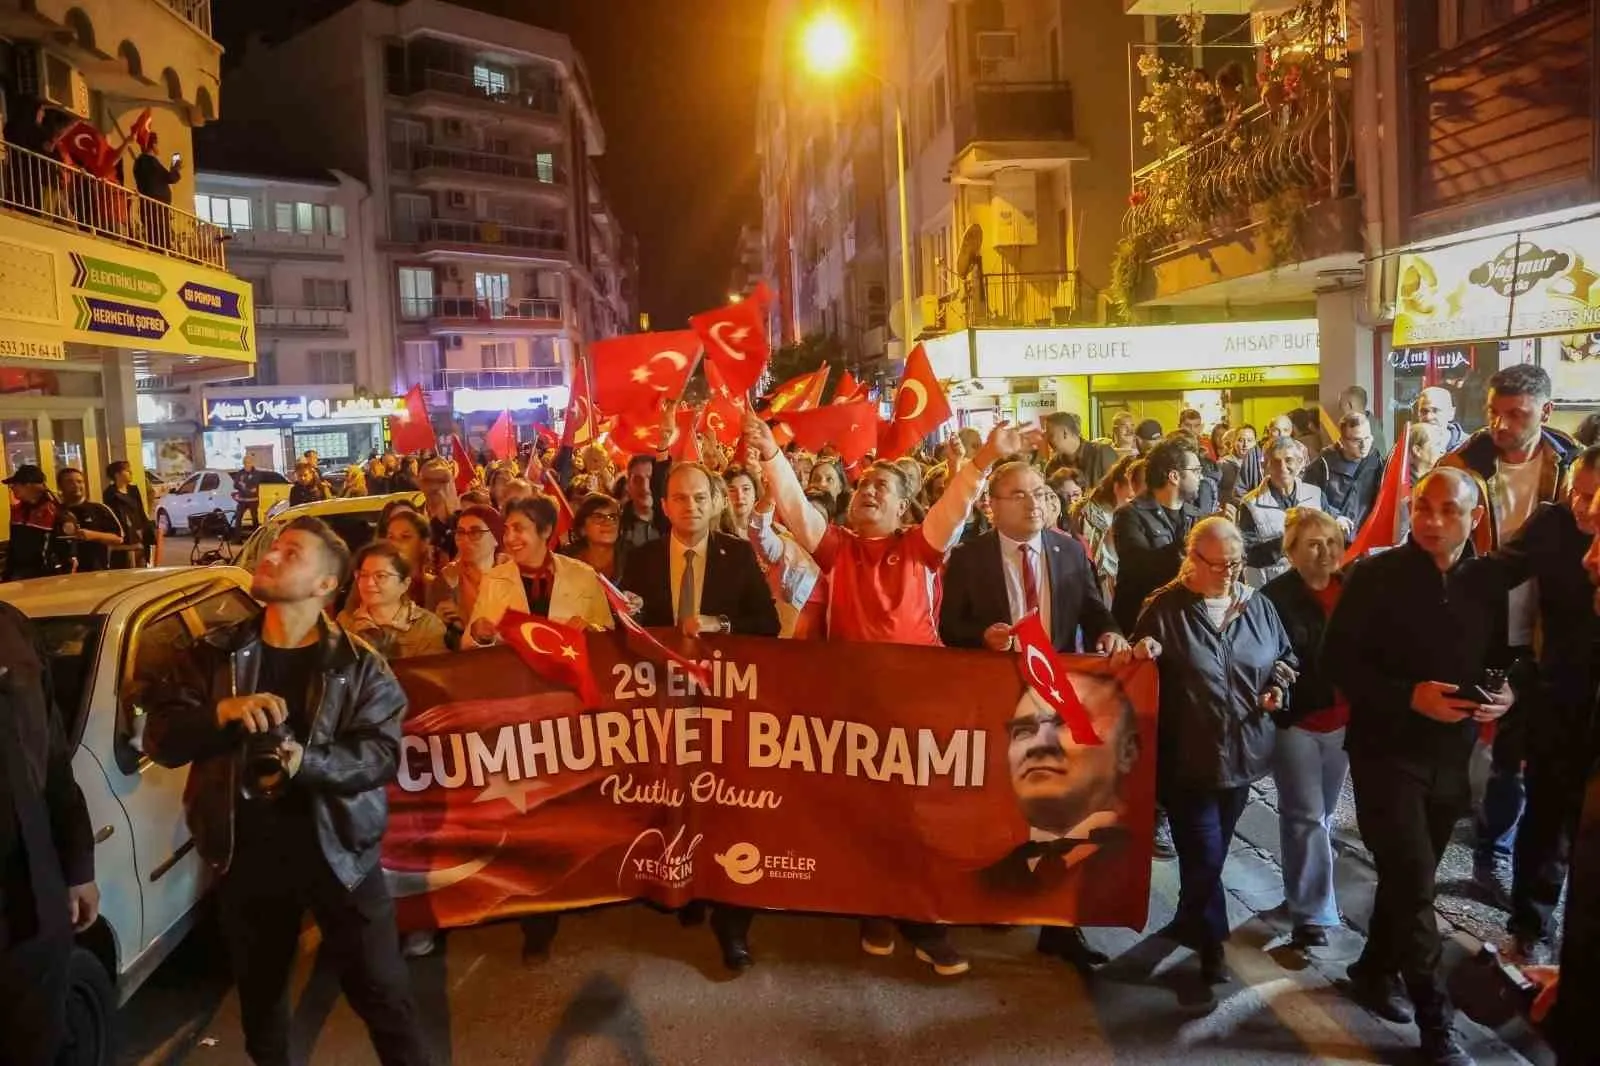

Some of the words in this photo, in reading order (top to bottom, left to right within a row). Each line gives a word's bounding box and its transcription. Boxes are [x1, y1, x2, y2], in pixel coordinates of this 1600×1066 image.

[92, 307, 136, 328] HERMETİK
[135, 315, 165, 332] ŞOFBEN
[612, 661, 657, 700] 29
[667, 650, 757, 700] EKİM
[396, 706, 733, 792] CUMHURİYET
[749, 711, 986, 787] BAYRAMI
[600, 773, 685, 807] Kutlu
[689, 771, 783, 809] Olsun
[764, 855, 816, 871] EFELER
